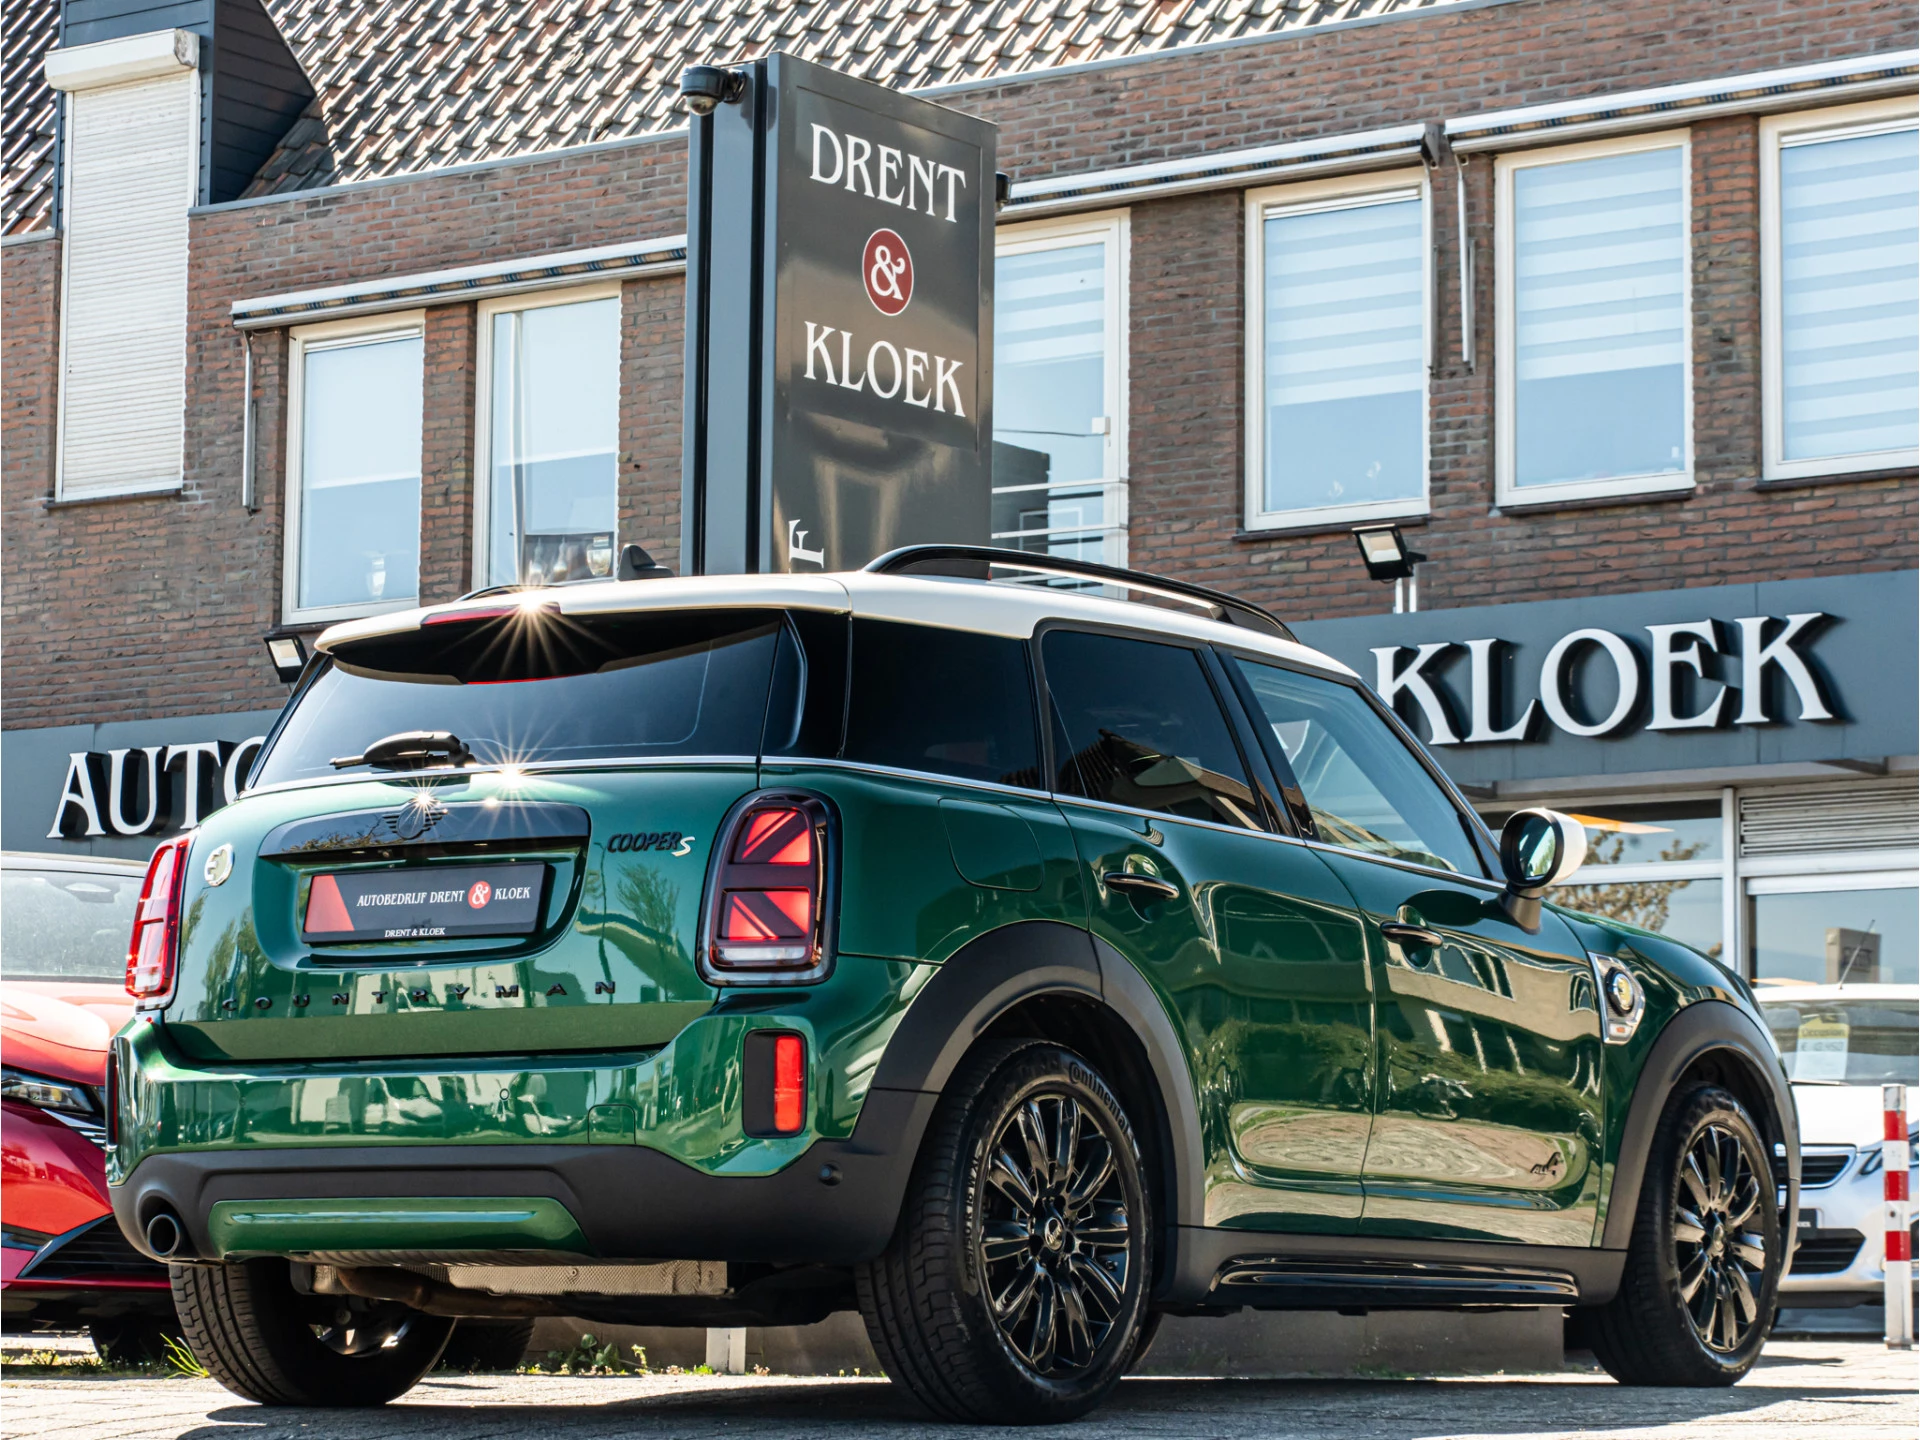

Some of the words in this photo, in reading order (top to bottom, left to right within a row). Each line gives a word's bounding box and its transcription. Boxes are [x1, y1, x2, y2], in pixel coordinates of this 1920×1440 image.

[809, 122, 966, 223] DRENT
[870, 245, 906, 301] &
[803, 320, 966, 418] KLOEK
[1368, 612, 1834, 746] KLOEK
[607, 832, 682, 853] COOPER
[671, 836, 696, 857] S
[356, 892, 427, 907] AUTOBEDRIJF
[429, 890, 465, 904] DRENT
[472, 883, 489, 905] &
[495, 886, 531, 900] KLOEK
[384, 928, 411, 938] DRENT
[411, 929, 417, 937] &
[418, 927, 446, 937] KLOEK
[222, 981, 616, 1012] COUNTRYMAN
[1069, 1062, 1130, 1134] Continental
[963, 1226, 976, 1281] 225/50
